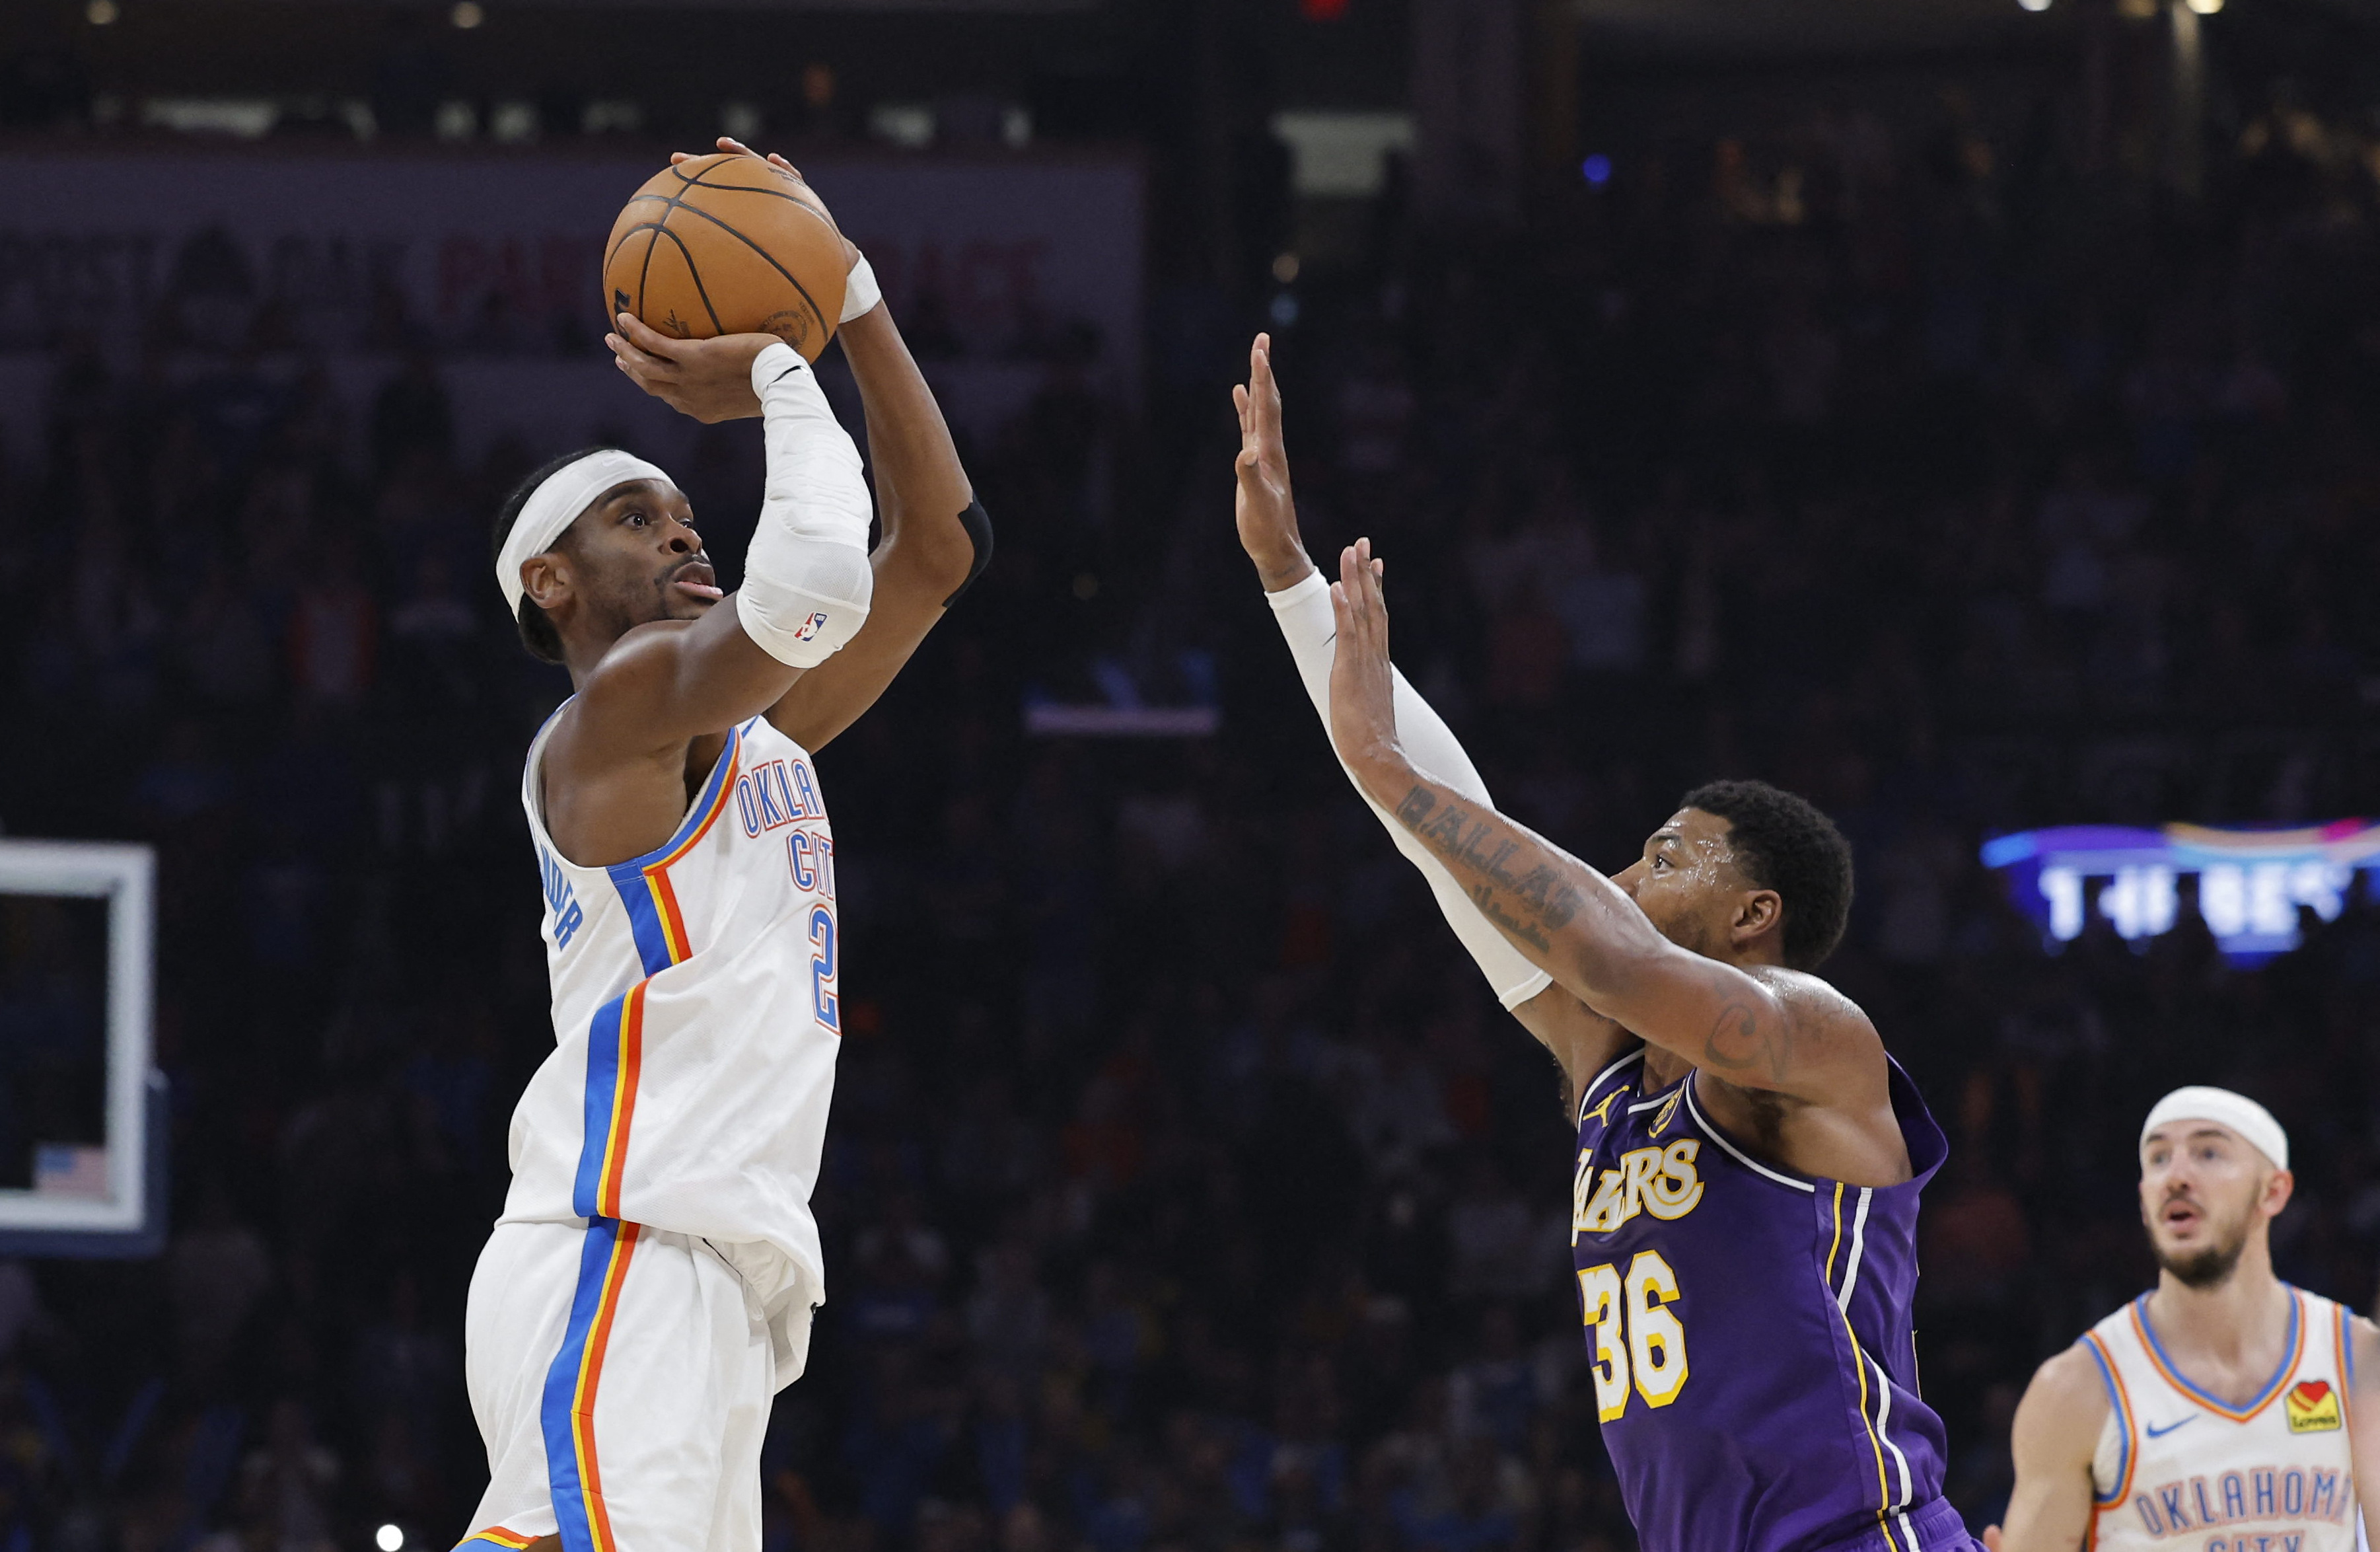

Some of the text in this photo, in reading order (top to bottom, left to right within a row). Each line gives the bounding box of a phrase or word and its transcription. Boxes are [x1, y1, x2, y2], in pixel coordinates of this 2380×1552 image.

[737, 758, 830, 838] OKLA
[808, 903, 842, 1036] 2
[1576, 1249, 1688, 1424] 36
